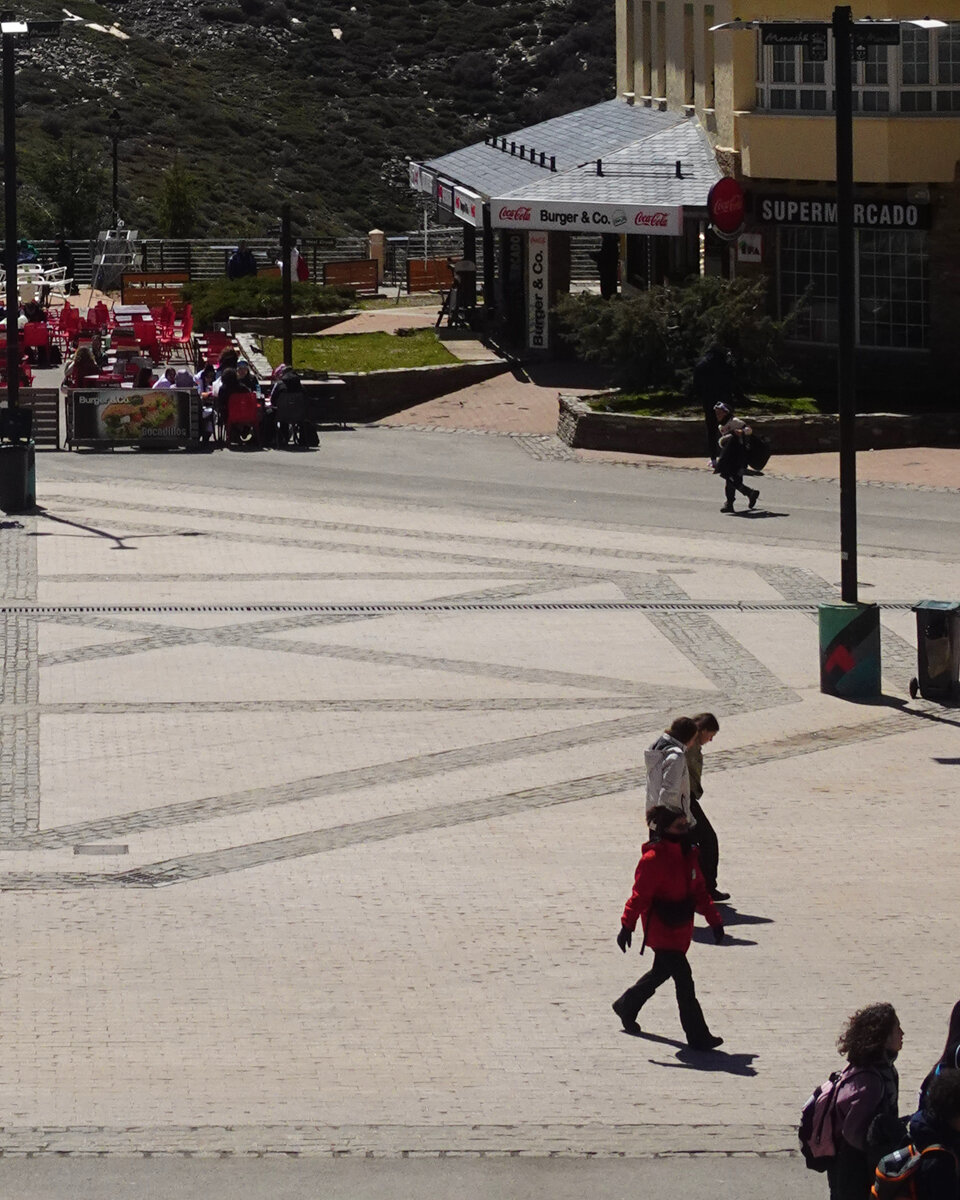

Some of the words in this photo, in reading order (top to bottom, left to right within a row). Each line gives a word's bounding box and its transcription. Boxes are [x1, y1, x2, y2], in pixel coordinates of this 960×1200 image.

[540, 209, 578, 225] Burger
[581, 212, 590, 223] &
[592, 211, 611, 225] Co.
[762, 199, 918, 227] SUPERMRCADO
[532, 250, 544, 275] Co.
[533, 278, 543, 290] &
[533, 294, 545, 347] Burger
[78, 395, 110, 406] Burger
